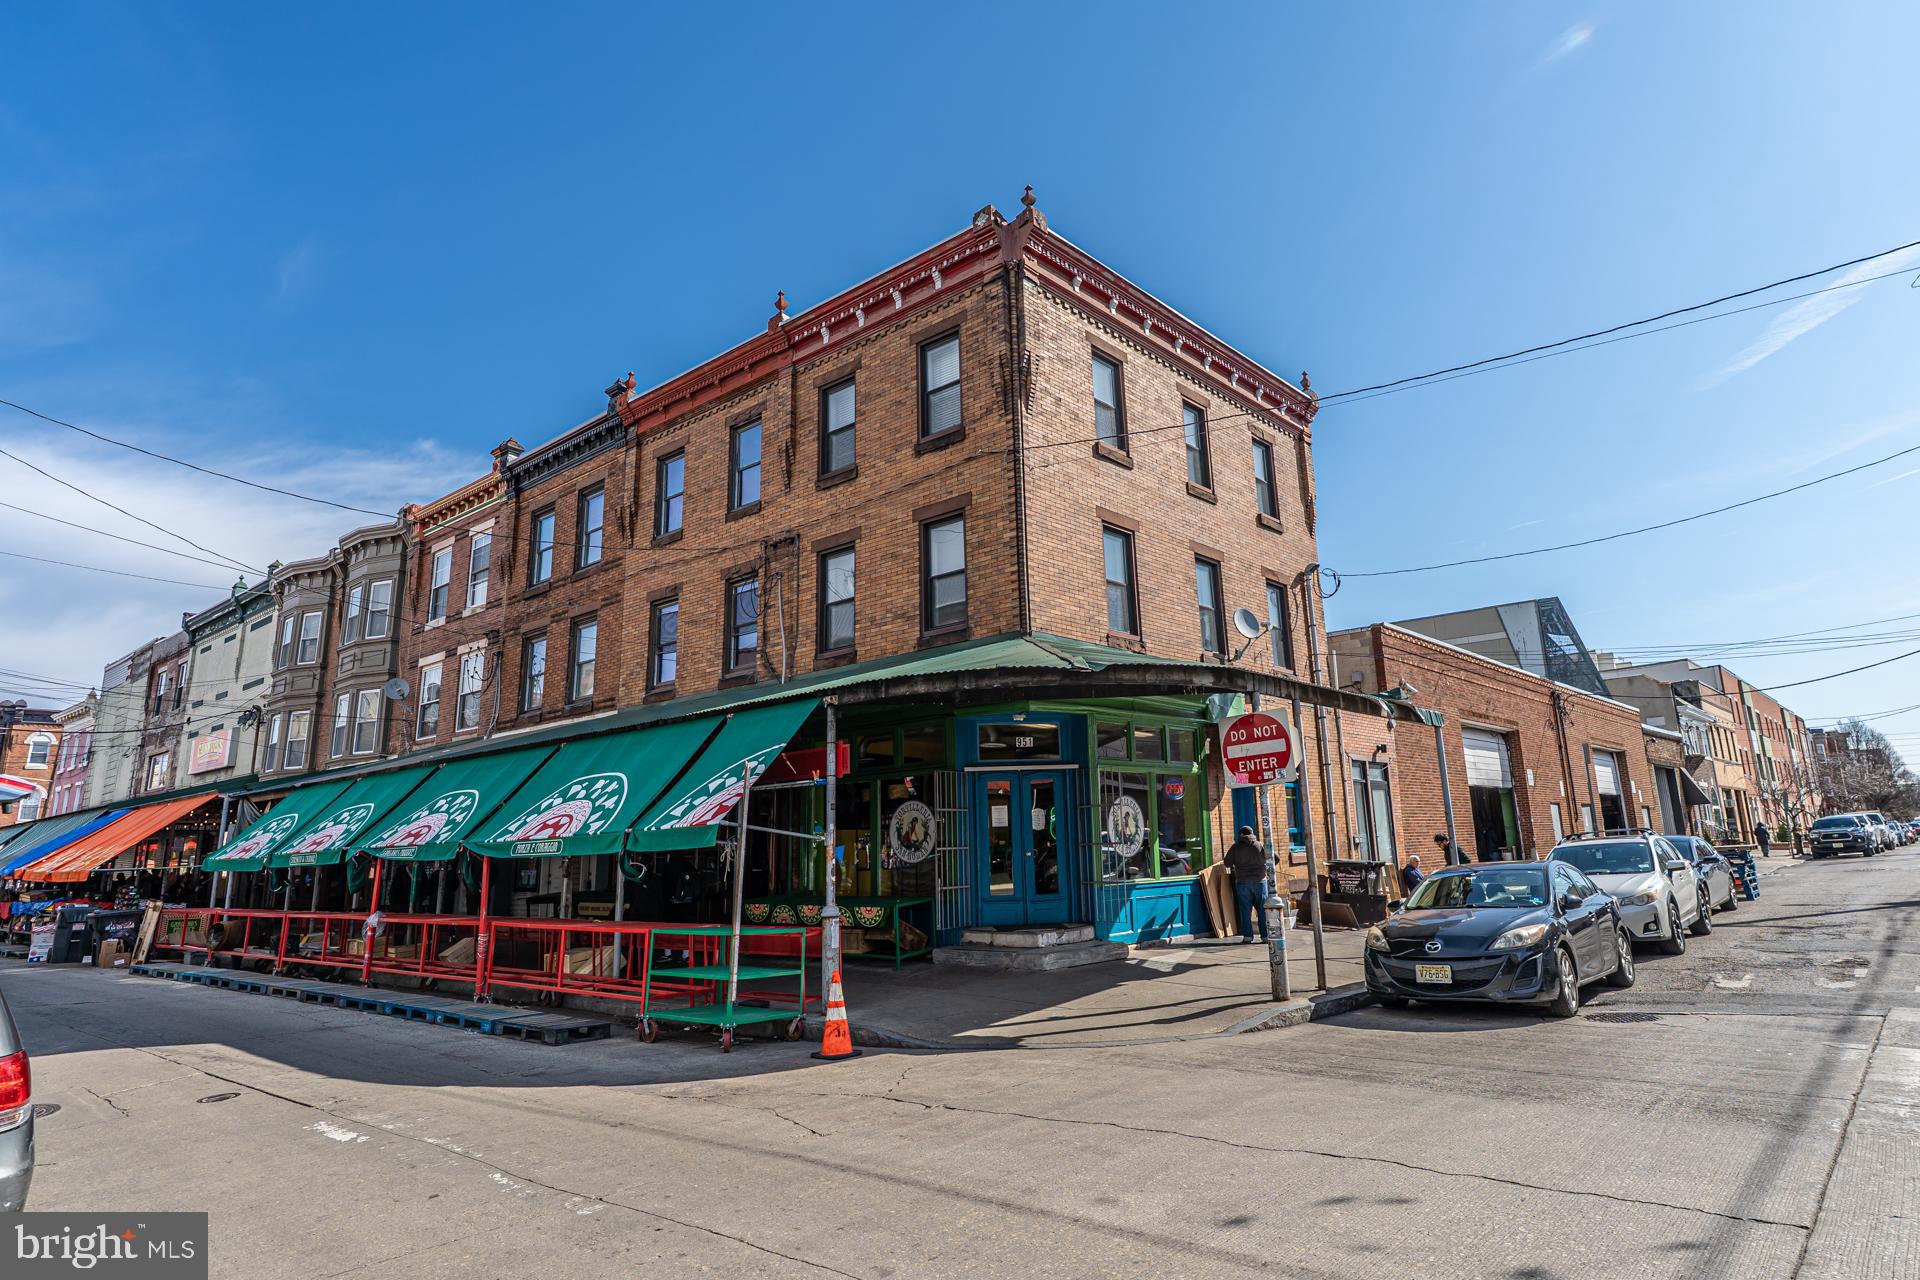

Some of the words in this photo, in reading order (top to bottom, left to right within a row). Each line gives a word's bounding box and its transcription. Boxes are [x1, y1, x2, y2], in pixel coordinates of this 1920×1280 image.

[1230, 729, 1247, 742] DO
[1253, 724, 1278, 739] NOT
[1016, 737, 1032, 747] 951
[1238, 756, 1278, 773] ENTER
[515, 843, 531, 853] FORZA
